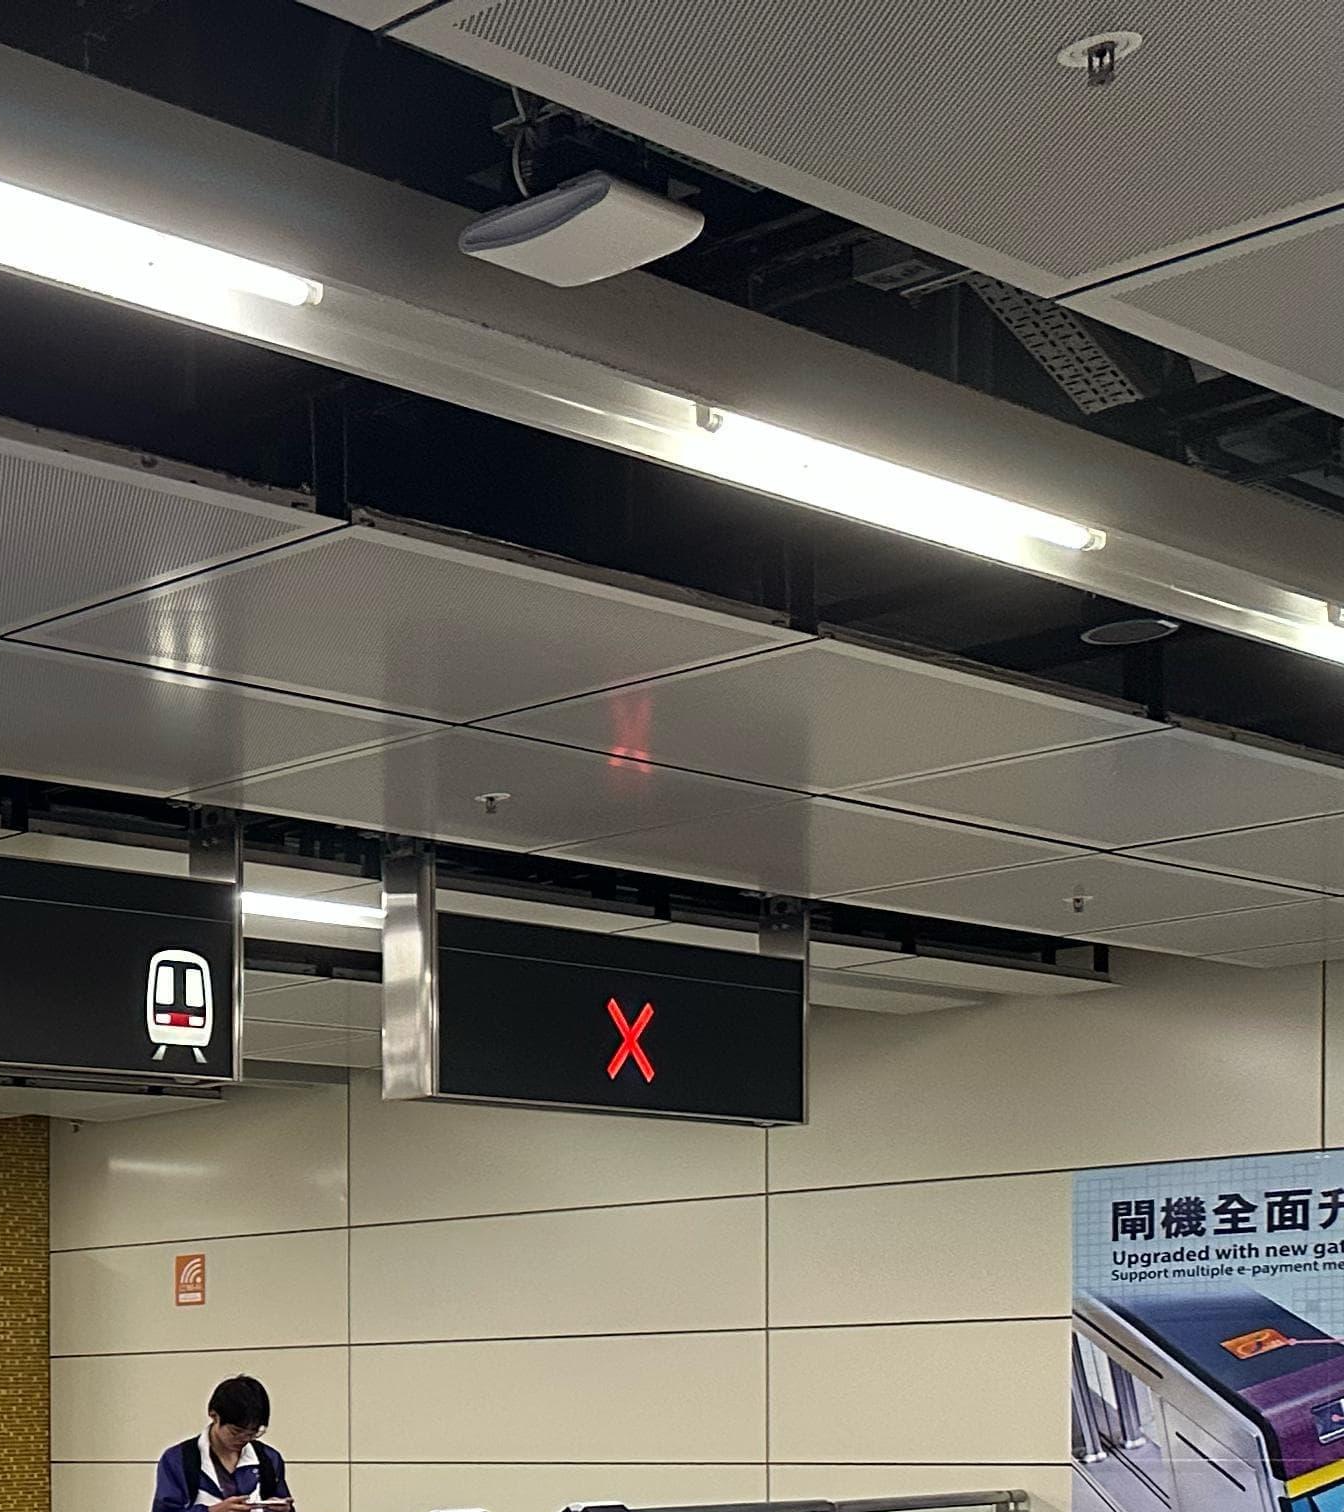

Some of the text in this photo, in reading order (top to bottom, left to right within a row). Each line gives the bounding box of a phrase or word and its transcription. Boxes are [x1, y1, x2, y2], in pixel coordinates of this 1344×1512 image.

[1112, 1245, 1210, 1268] Upgraded
[1215, 1243, 1260, 1260] with
[1265, 1244, 1308, 1258] new
[1111, 1268, 1170, 1282] Support
[1172, 1264, 1234, 1278] multiple
[1237, 1260, 1319, 1277] e-payment
